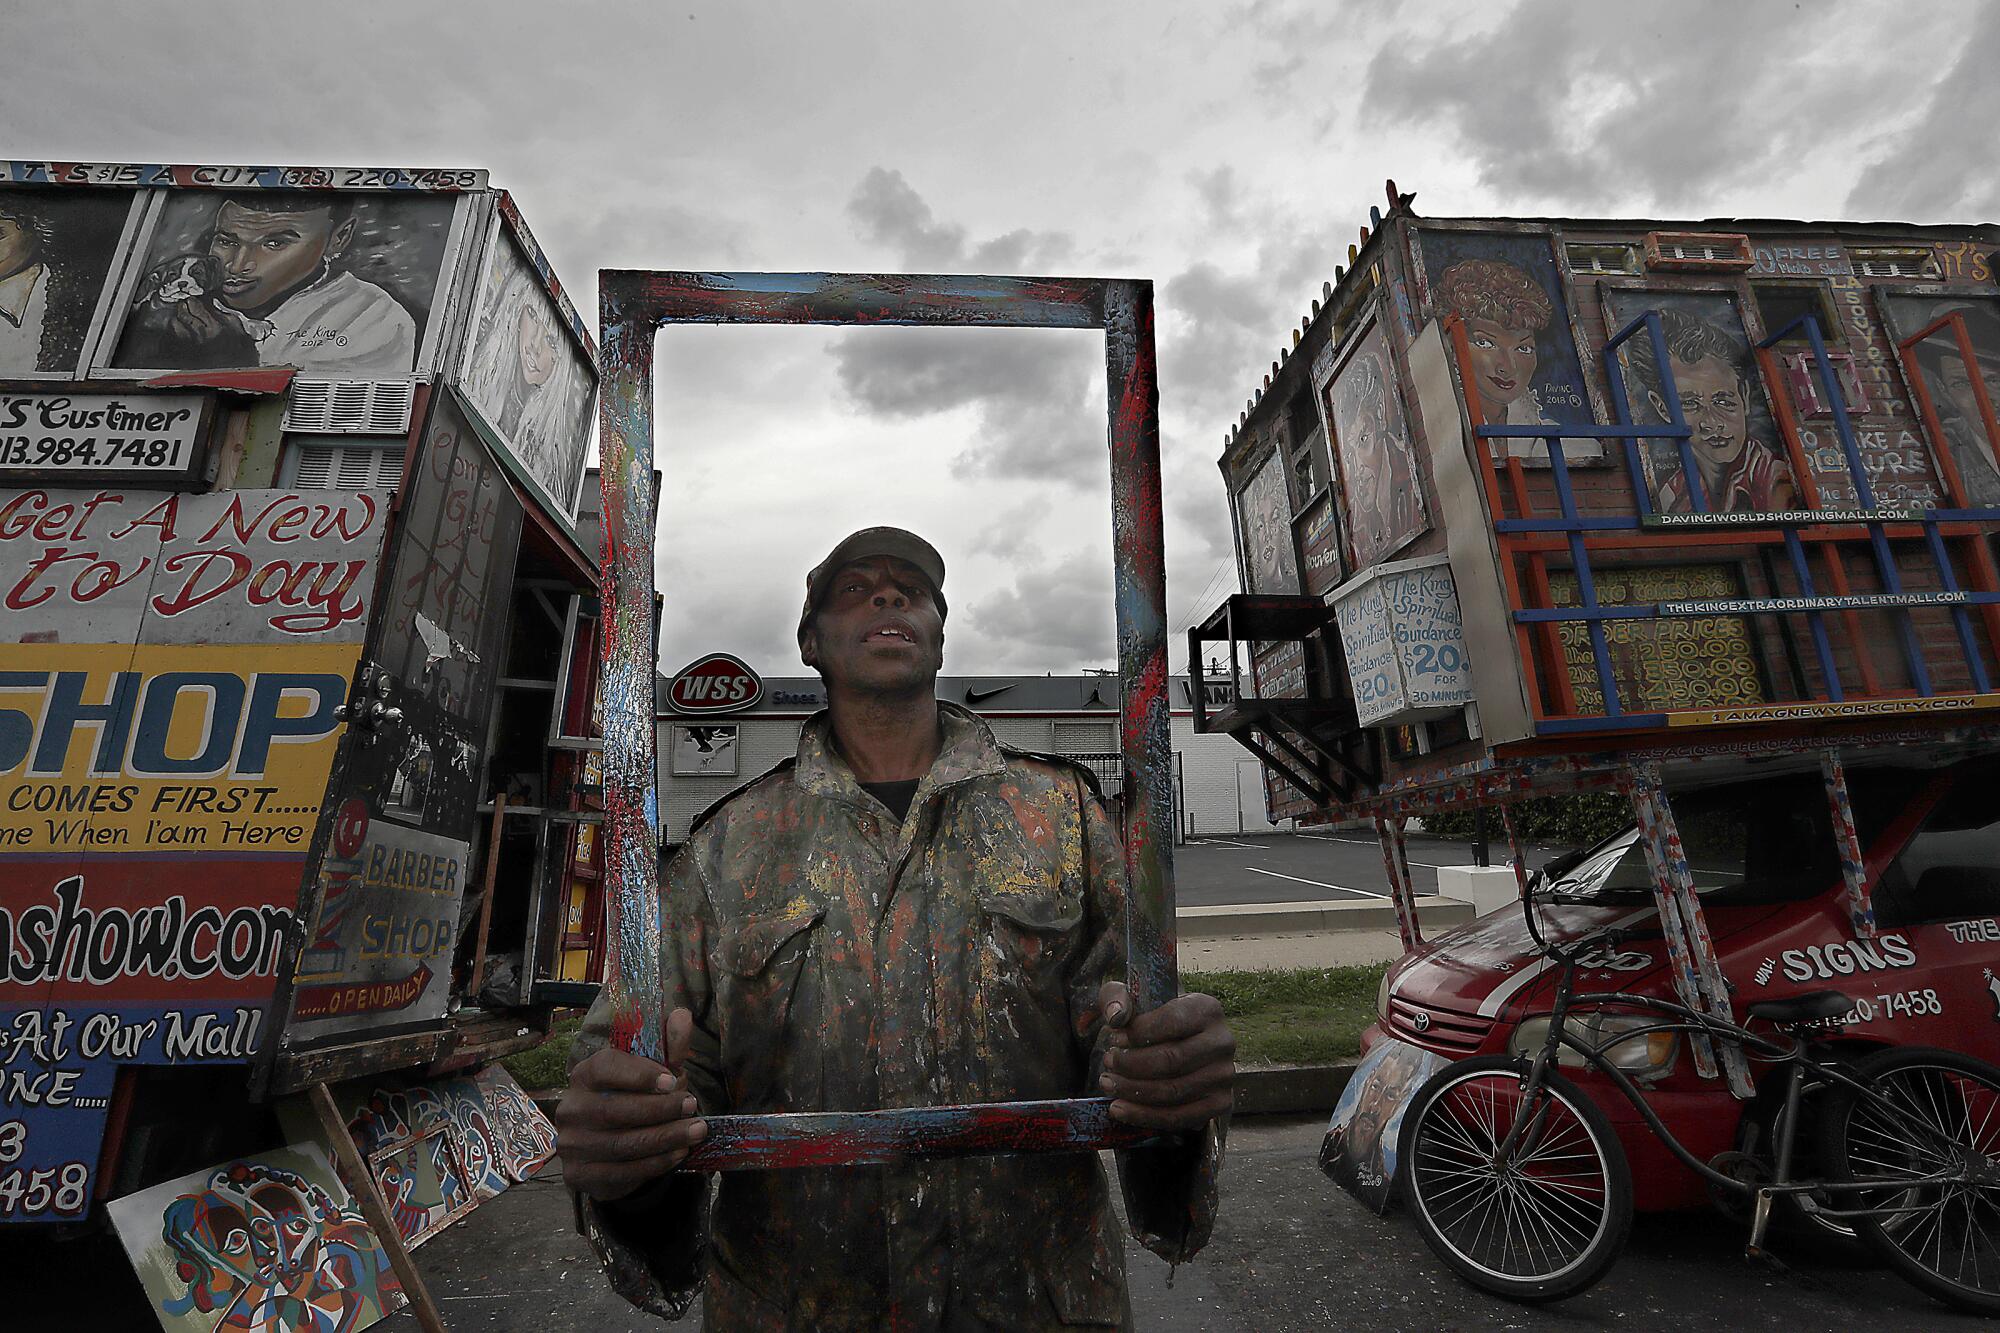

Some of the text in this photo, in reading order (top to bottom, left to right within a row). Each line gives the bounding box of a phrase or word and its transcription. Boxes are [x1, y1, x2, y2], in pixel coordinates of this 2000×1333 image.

[192, 167, 269, 185] CUT
[344, 170, 477, 187] 220-7458
[1773, 247, 1841, 260] FREE
[301, 339, 324, 347] 2012
[313, 325, 337, 341] King
[0, 436, 183, 467] 13.984.7481
[0, 490, 377, 548] Get A New
[1660, 510, 1909, 525] DAVINCIWORLDSHOPPINGMALL.COM
[151, 545, 368, 635] Day
[1386, 571, 1455, 603] The King
[1338, 599, 1358, 630] The
[1394, 618, 1463, 643] Guidance
[1653, 617, 1746, 641] PRICES
[680, 675, 751, 701] WSS
[1434, 675, 1458, 685] FOR
[1412, 691, 1430, 702] 30
[8, 785, 140, 813] COMES
[45, 819, 130, 845] When
[222, 820, 305, 845] Here
[365, 843, 459, 896] BARBER
[361, 914, 453, 959] SHOP
[1754, 933, 1917, 986] WALL SIGNS
[81, 1013, 158, 1058] Our
[164, 1008, 262, 1062] Mall
